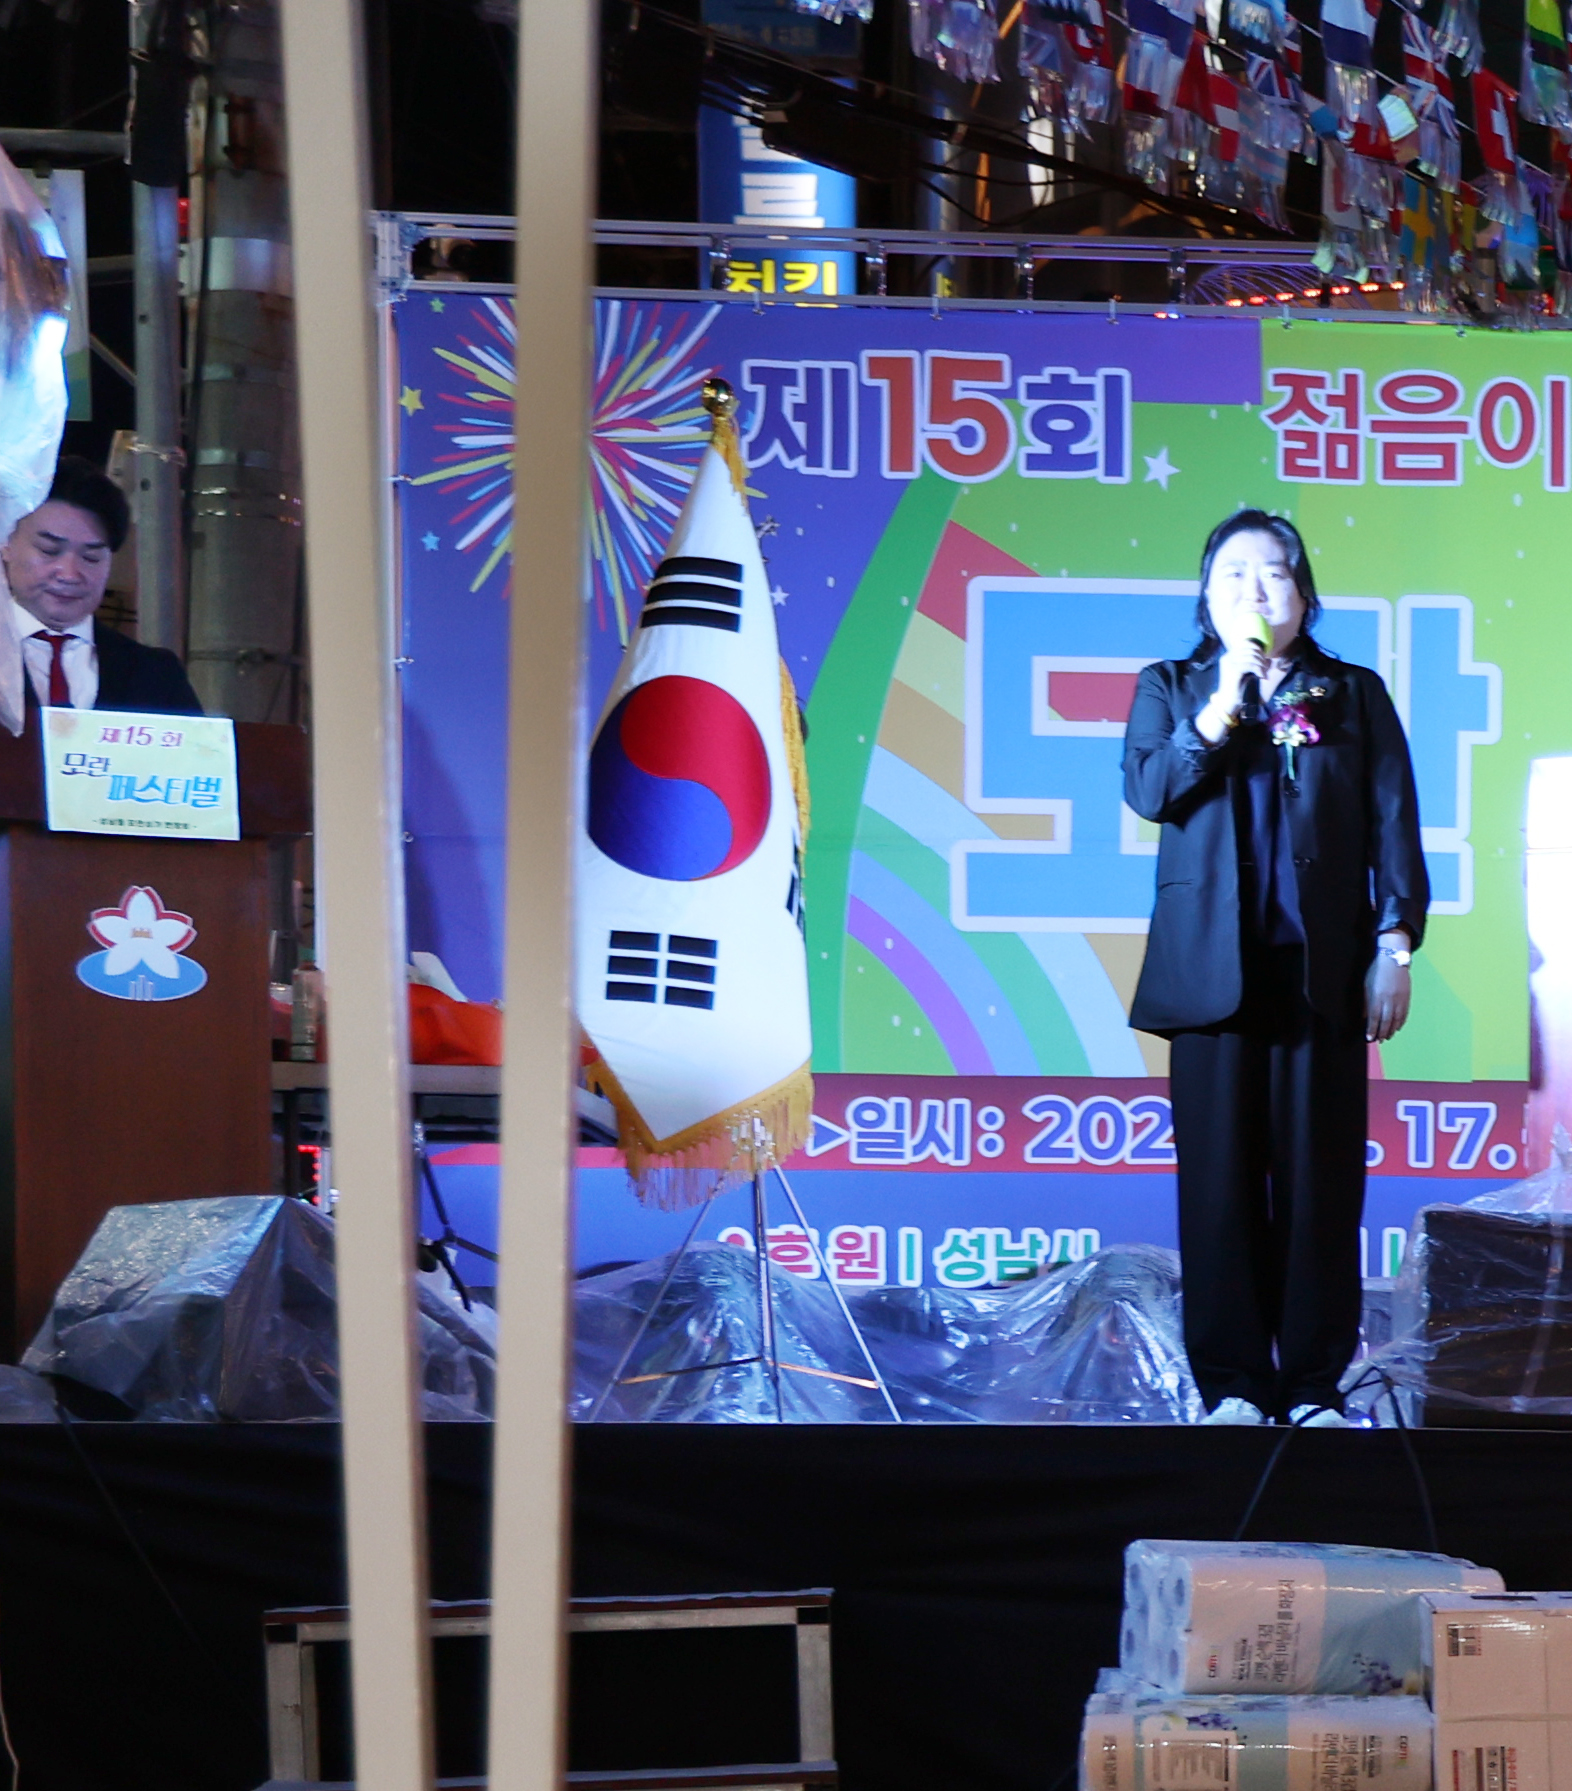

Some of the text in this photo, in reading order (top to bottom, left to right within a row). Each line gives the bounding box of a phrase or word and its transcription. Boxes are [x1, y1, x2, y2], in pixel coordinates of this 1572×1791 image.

[741, 349, 1132, 484] 제15회
[106, 772, 224, 810] 페스티벌
[845, 1095, 1006, 1167] 일시:
